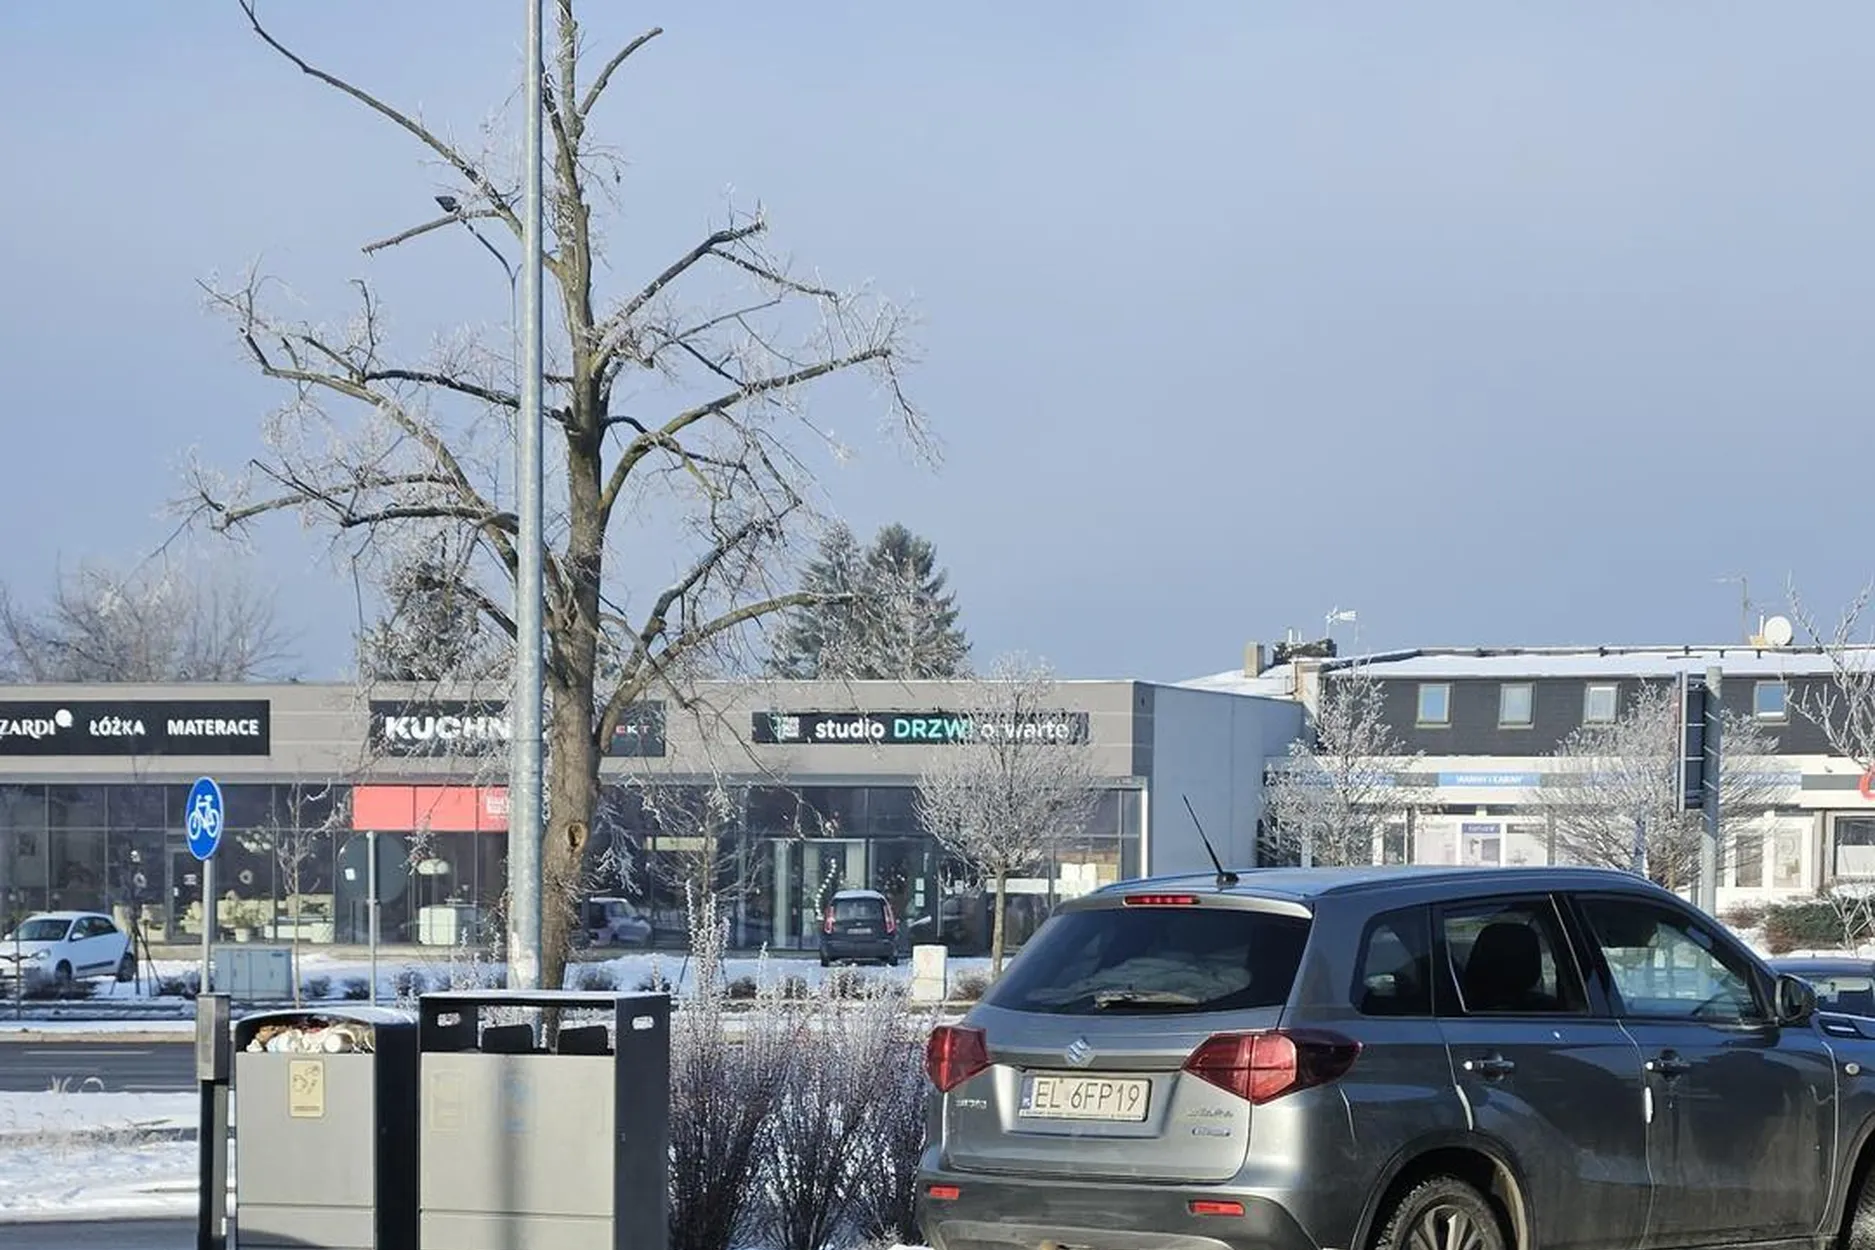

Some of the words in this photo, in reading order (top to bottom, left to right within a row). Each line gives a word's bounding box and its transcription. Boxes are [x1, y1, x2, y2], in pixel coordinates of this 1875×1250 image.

[89, 715, 146, 736] ŁÓŻKA
[167, 719, 260, 736] MATERACE
[385, 716, 513, 740] KUCHN
[815, 718, 885, 739] studio
[981, 720, 1070, 738] owarte
[1035, 1081, 1061, 1108] EL
[1071, 1082, 1140, 1112] 6FP19
